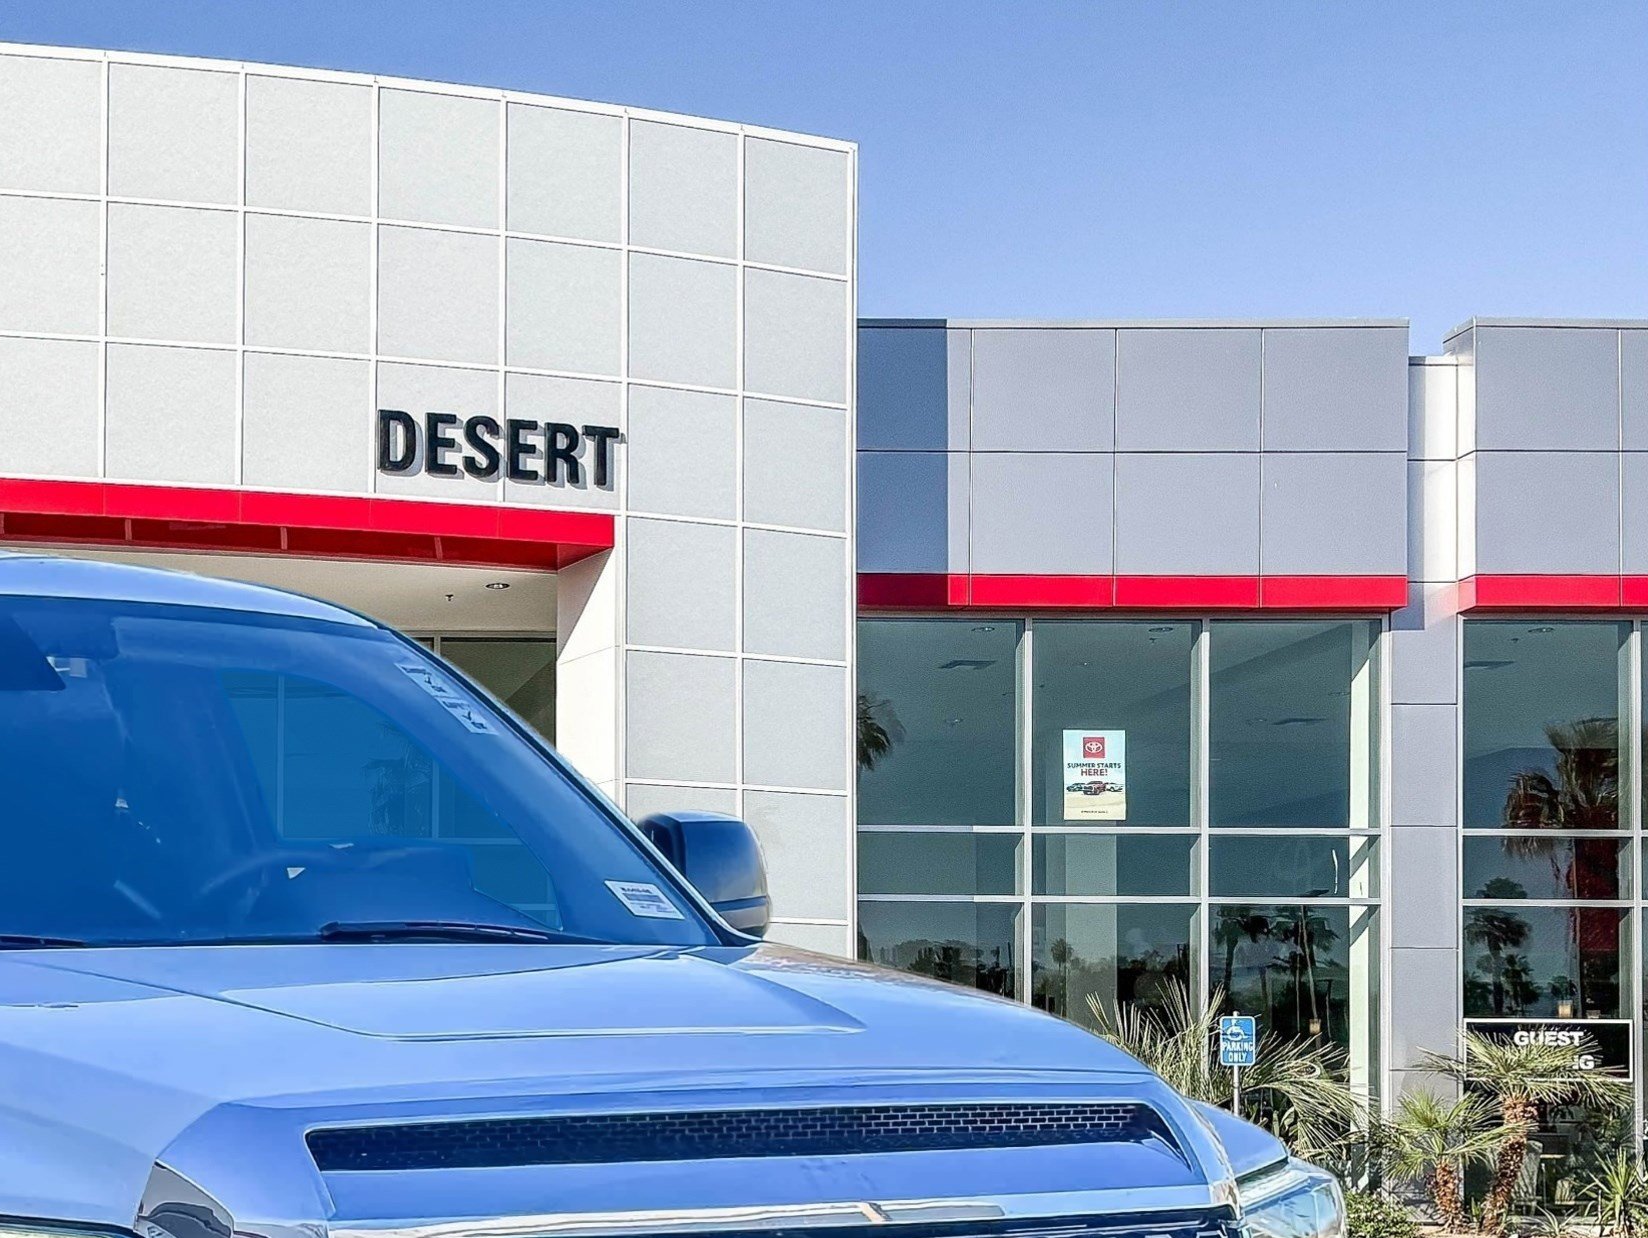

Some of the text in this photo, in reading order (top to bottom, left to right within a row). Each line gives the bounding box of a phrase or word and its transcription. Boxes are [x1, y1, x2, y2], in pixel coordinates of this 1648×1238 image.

[377, 409, 619, 487] DESERT
[1081, 768, 1108, 776] HERE!
[1513, 1030, 1585, 1047] GUEST
[1222, 1041, 1253, 1051] PARKING
[1228, 1052, 1248, 1063] ONLY
